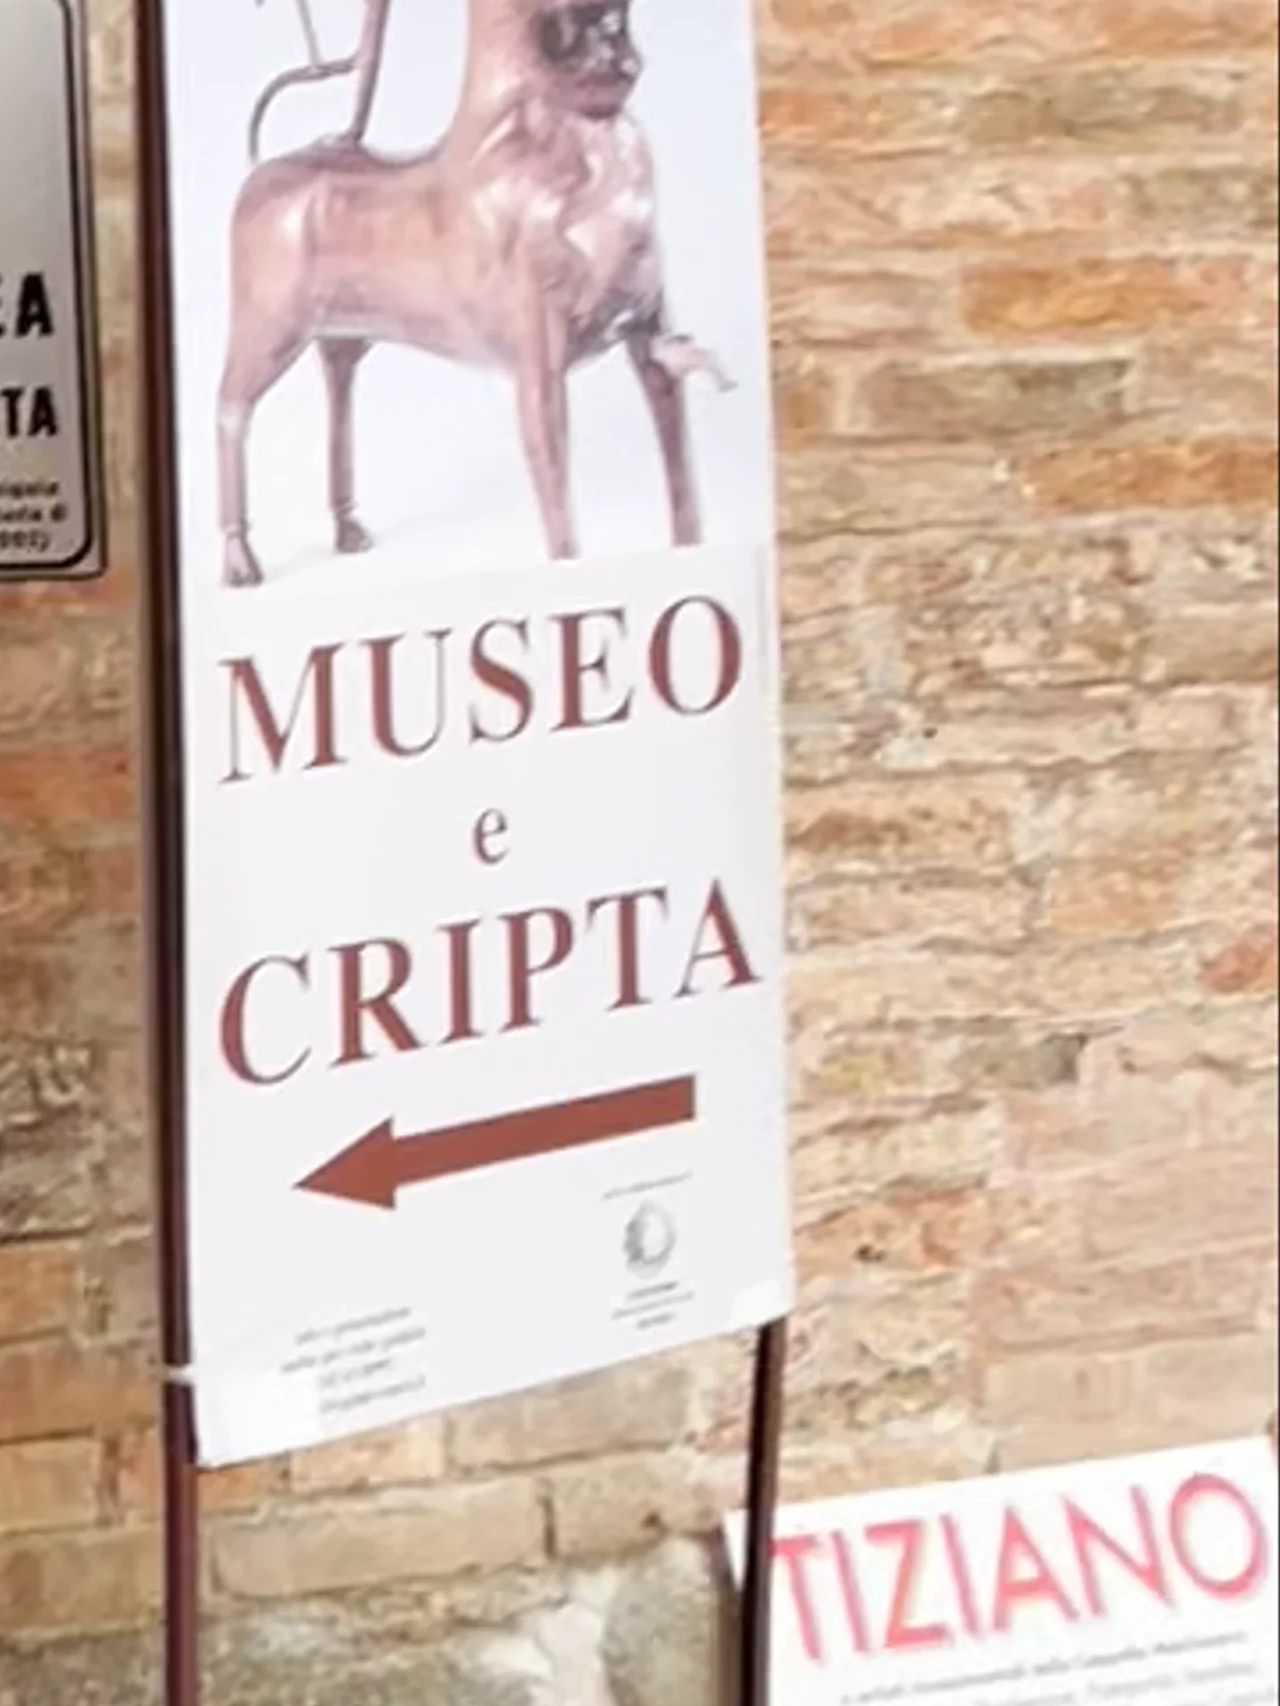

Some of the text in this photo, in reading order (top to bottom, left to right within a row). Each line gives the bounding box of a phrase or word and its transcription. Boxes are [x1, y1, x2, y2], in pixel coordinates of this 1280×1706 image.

[218, 595, 744, 786] MUSEO
[472, 807, 510, 866] e
[218, 877, 763, 1087] CRIPTA
[767, 1472, 1269, 1665] TIZIANO
